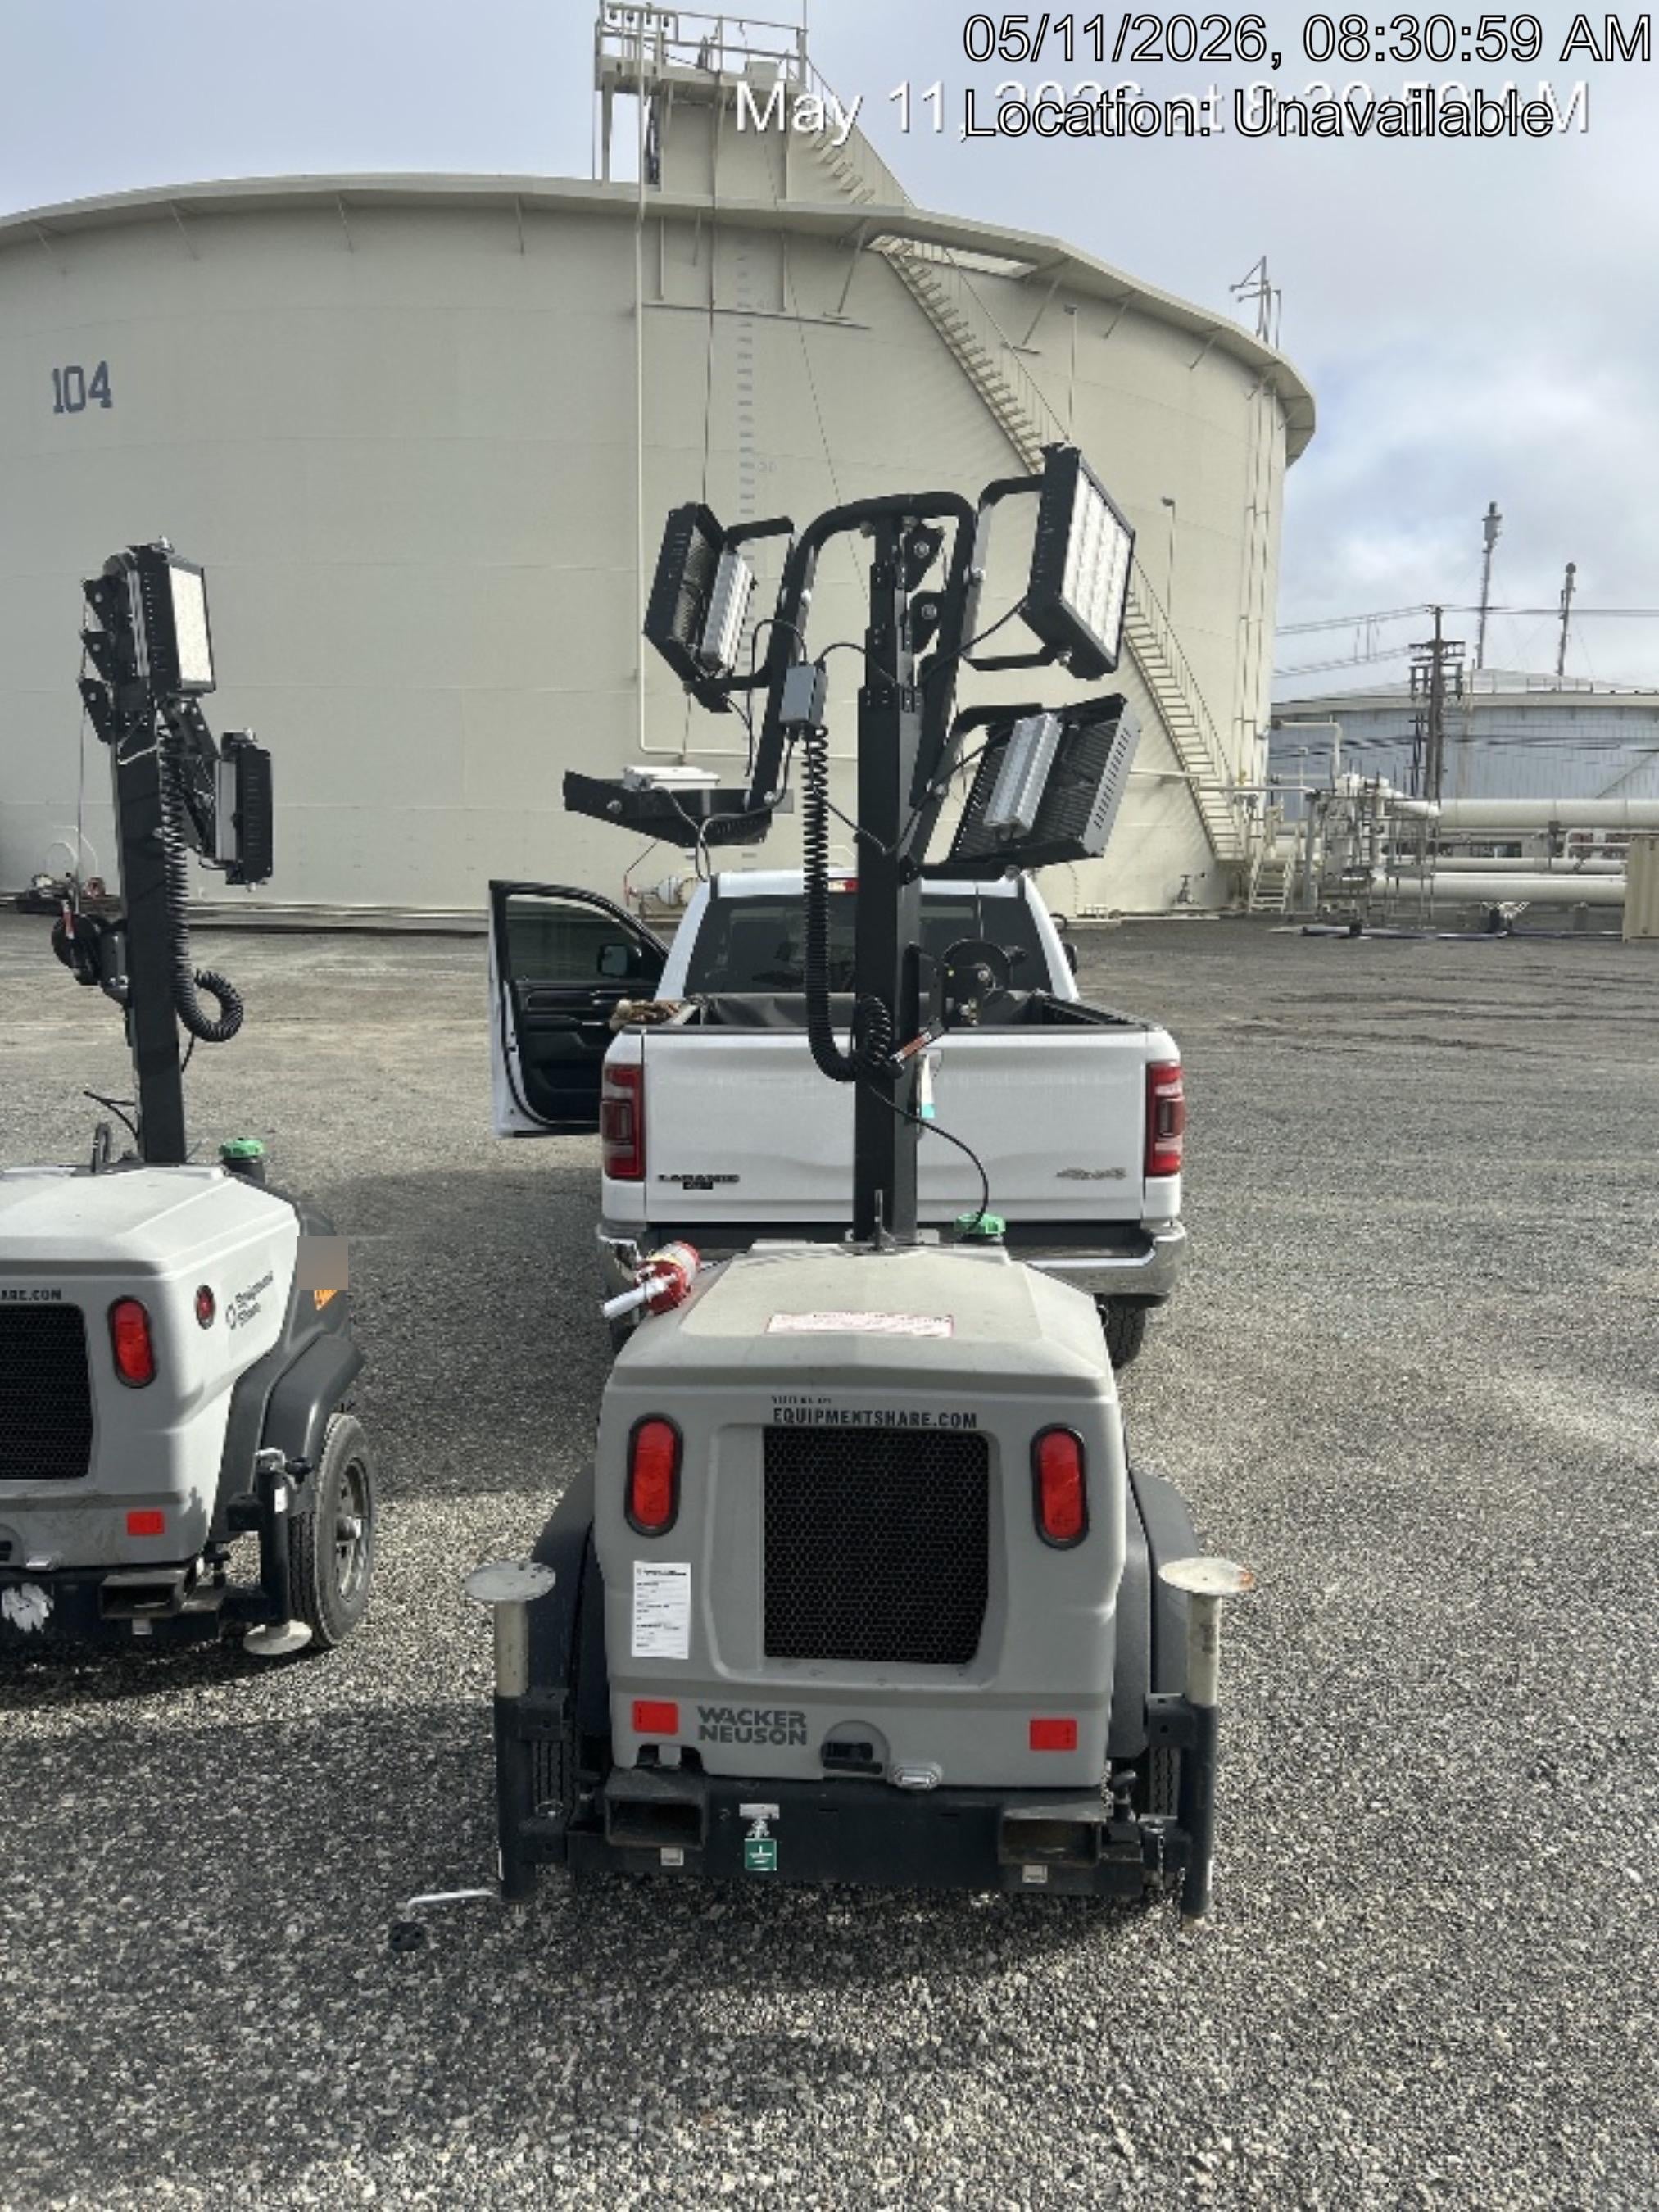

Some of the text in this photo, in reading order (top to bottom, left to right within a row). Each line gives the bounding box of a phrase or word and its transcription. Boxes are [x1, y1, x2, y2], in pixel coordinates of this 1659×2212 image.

[52, 360, 112, 413] 104
[773, 1407, 977, 1429] EQUIPMENTSHARE.COM
[696, 1705, 807, 1728] WACKER
[698, 1725, 807, 1745] NEUSON
